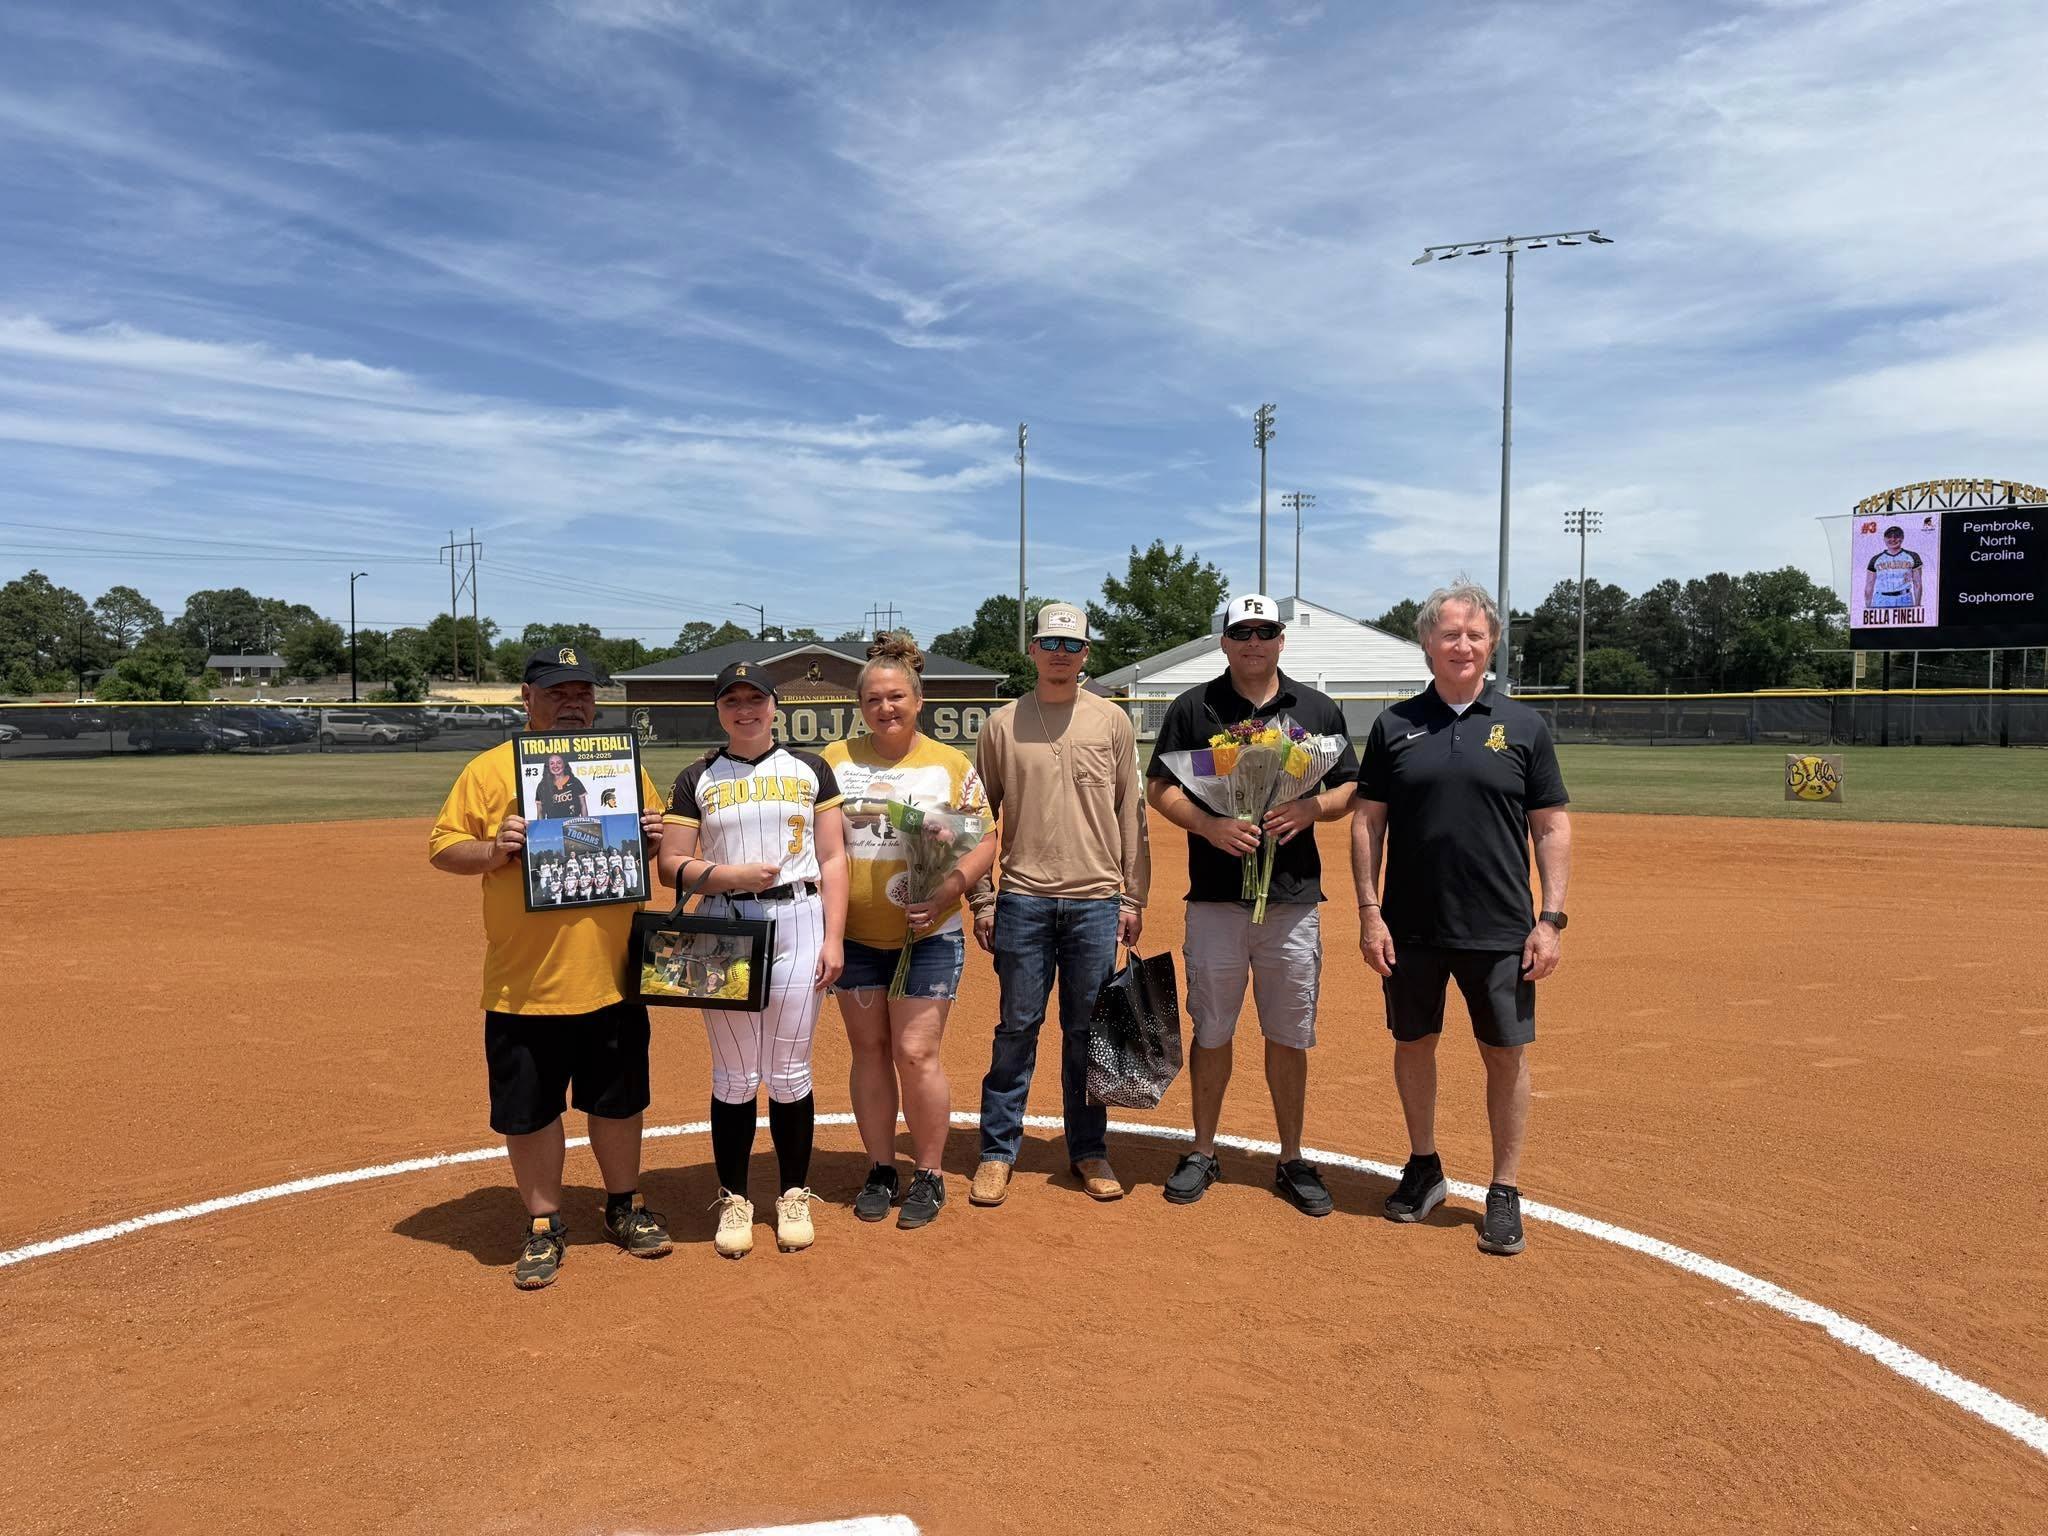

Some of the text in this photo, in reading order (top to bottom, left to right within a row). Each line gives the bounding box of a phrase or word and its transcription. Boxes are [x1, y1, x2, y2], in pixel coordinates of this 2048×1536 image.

[1859, 478, 2047, 513] FAYETTEVILLE TECH
[1861, 522, 1877, 534] #3
[1963, 520, 2034, 532] Pembroke,
[1980, 535, 2016, 546] North
[1970, 550, 2025, 562] Carolina
[1958, 592, 2034, 604] Sophomore
[1244, 599, 1264, 615] FE
[1863, 608, 1925, 625] BELLA FINELLI
[770, 708, 875, 741] ROJA
[522, 736, 631, 755] TROJAN SOFTBALL
[577, 752, 612, 760] 2024-2025
[525, 767, 539, 777] #3
[1787, 761, 1842, 787] Bella
[703, 776, 811, 815] TROJANS
[567, 828, 600, 845] TROJANS
[788, 815, 806, 855] 3
